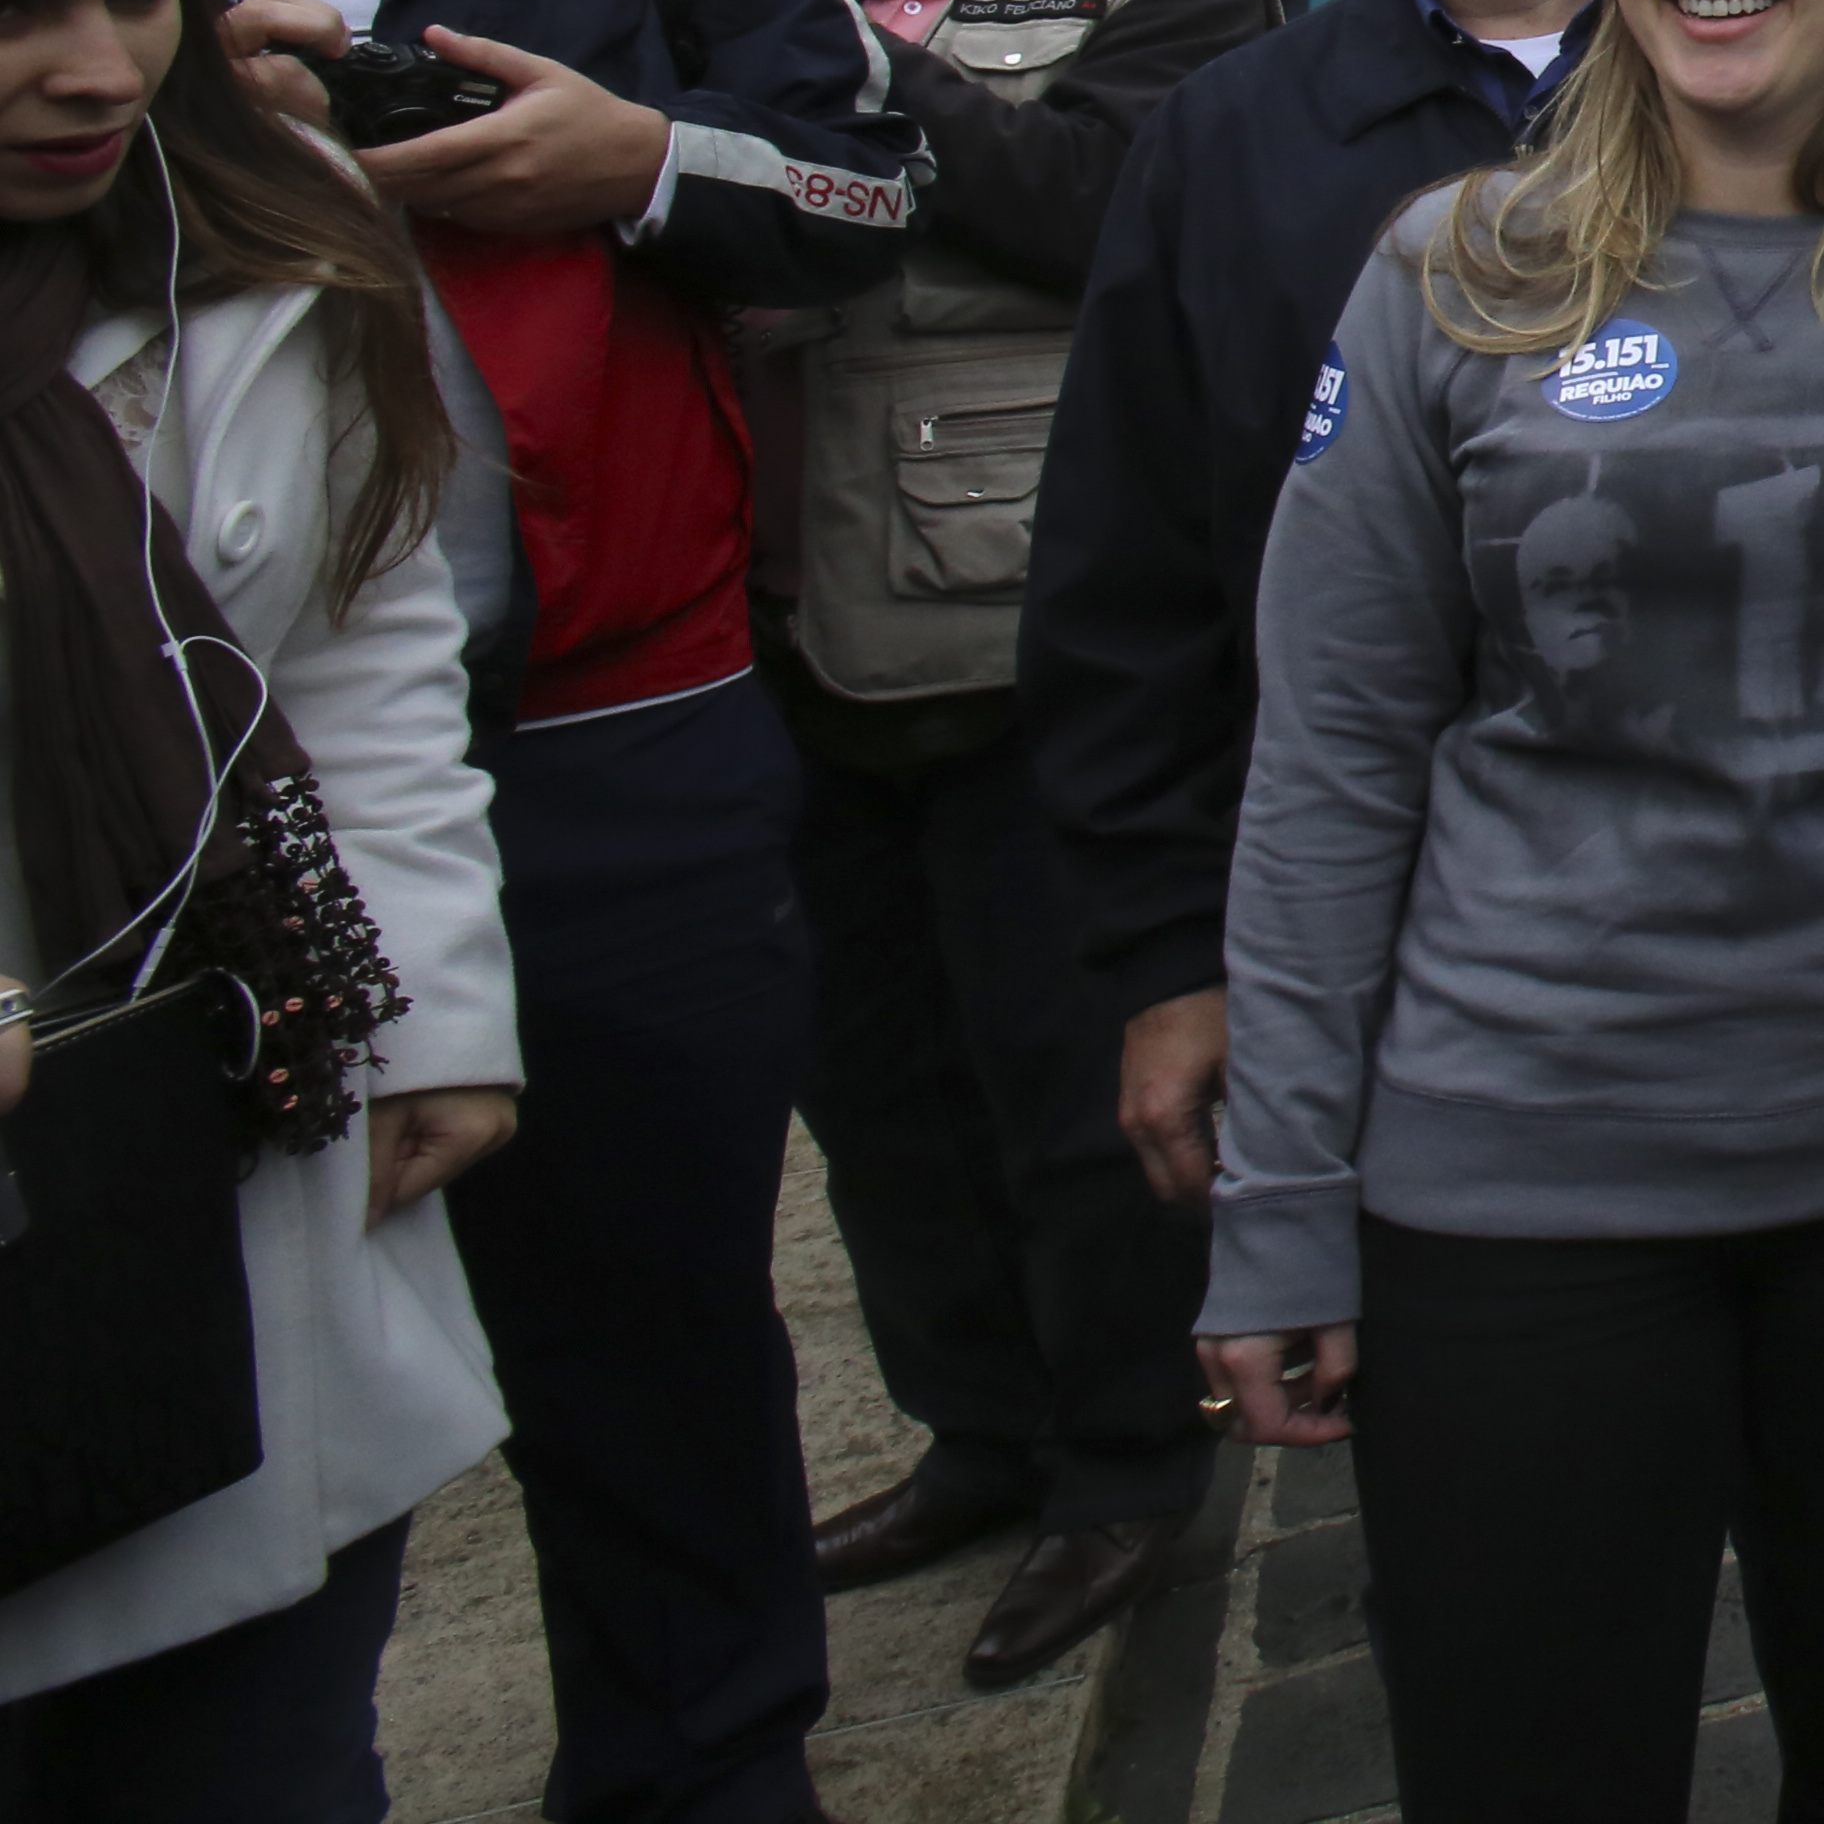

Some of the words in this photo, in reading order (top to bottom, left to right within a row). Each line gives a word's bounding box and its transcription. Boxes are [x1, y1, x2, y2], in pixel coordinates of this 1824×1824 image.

[960, 3, 998, 15] KIKO
[1558, 334, 1660, 378] 15.151
[1592, 391, 1633, 405] FILHO
